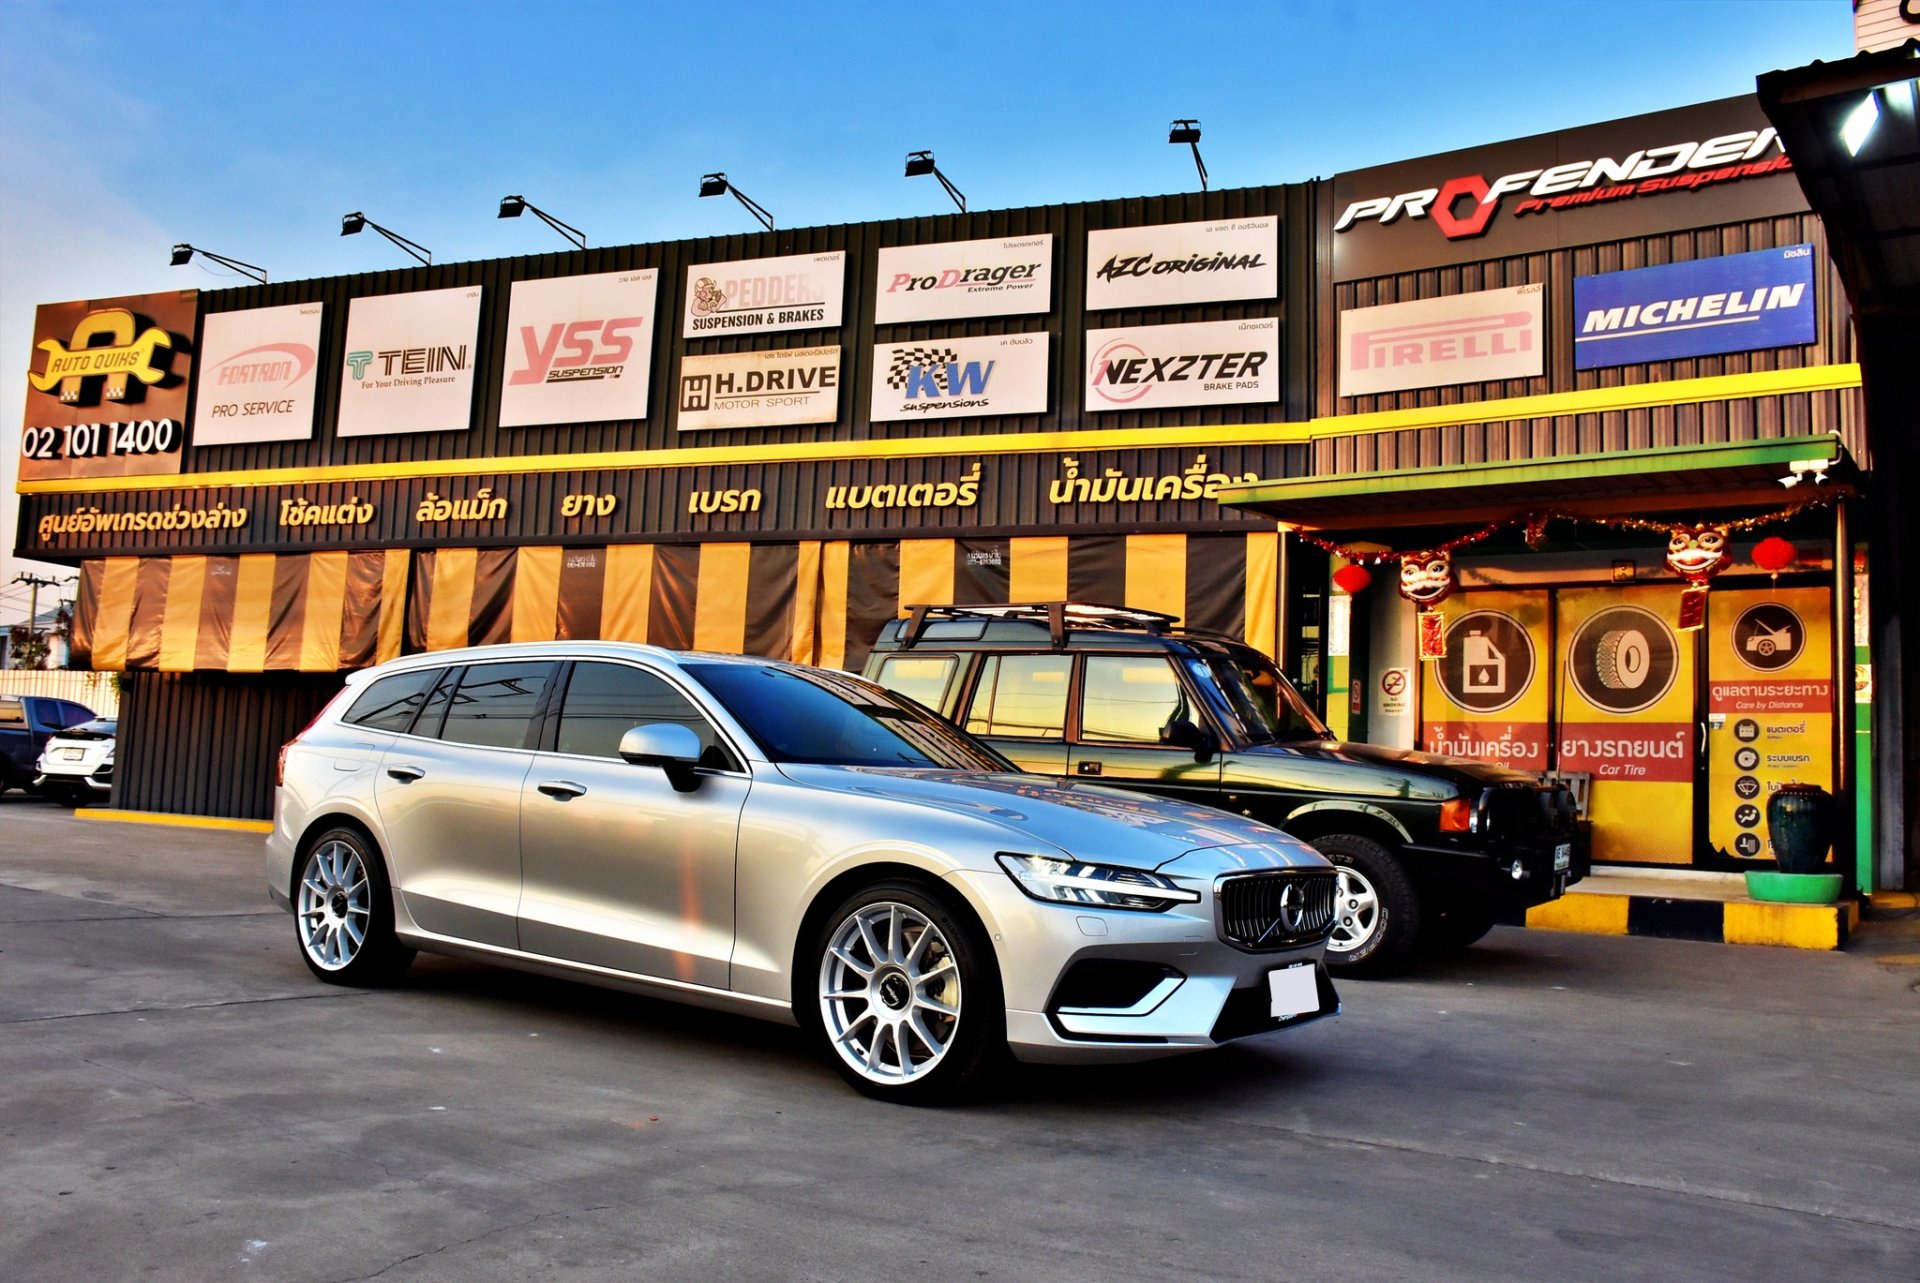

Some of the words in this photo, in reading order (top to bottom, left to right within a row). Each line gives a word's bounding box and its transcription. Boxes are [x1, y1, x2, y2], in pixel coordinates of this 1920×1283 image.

[1514, 184, 1636, 215] Premium
[886, 263, 1041, 293] ProDrager
[1096, 253, 1153, 283] AZC
[967, 285, 1004, 293] Extreme
[692, 313, 763, 331] SUSPENSION
[766, 312, 775, 325] &
[778, 308, 824, 324] BRAKES
[1582, 283, 1805, 333] MICHELIN
[508, 316, 644, 386] YSS
[1351, 311, 1533, 371] PIRELLI
[51, 355, 91, 374] AUTO
[378, 345, 467, 376] TEIN
[548, 365, 624, 379] SUSPENSION
[1092, 351, 1268, 386] NEXZTER
[361, 381, 373, 389] For
[375, 380, 392, 388] Your
[394, 377, 422, 388] Driving
[424, 375, 456, 385] Pleasure
[715, 366, 837, 394] H.DRIVE
[905, 360, 995, 399] KW
[1204, 382, 1233, 391] BRAKE
[1236, 381, 1259, 389] PADS
[211, 404, 238, 418] PRO
[242, 400, 295, 416] SERVICE
[714, 399, 760, 411] MOTOR
[766, 396, 811, 408] SPORT
[900, 398, 990, 414] suspensions
[22, 426, 55, 458] 02
[64, 423, 101, 456] 101
[110, 418, 173, 454] 1400
[39, 501, 248, 541] ศูนย์อัพเกรดช่วงล่าง
[279, 496, 375, 526] โช้คแต่ง
[416, 488, 508, 522] ล้อแม็ก
[561, 494, 616, 517] ยาง
[688, 489, 761, 514] เบรก
[825, 462, 982, 509] แบตเตอรี่
[1712, 685, 1828, 702] ดูแลตามระยะทาง
[1735, 701, 1754, 710] Care
[1756, 701, 1766, 710] by
[1768, 701, 1804, 709] Distance
[1430, 725, 1538, 758] น้ำมันเครื่อง
[1562, 731, 1686, 758] ยางรถยนต์
[1599, 764, 1620, 775] Car
[1624, 764, 1646, 775] Tire
[1766, 754, 1810, 763] ระบบเบรก
